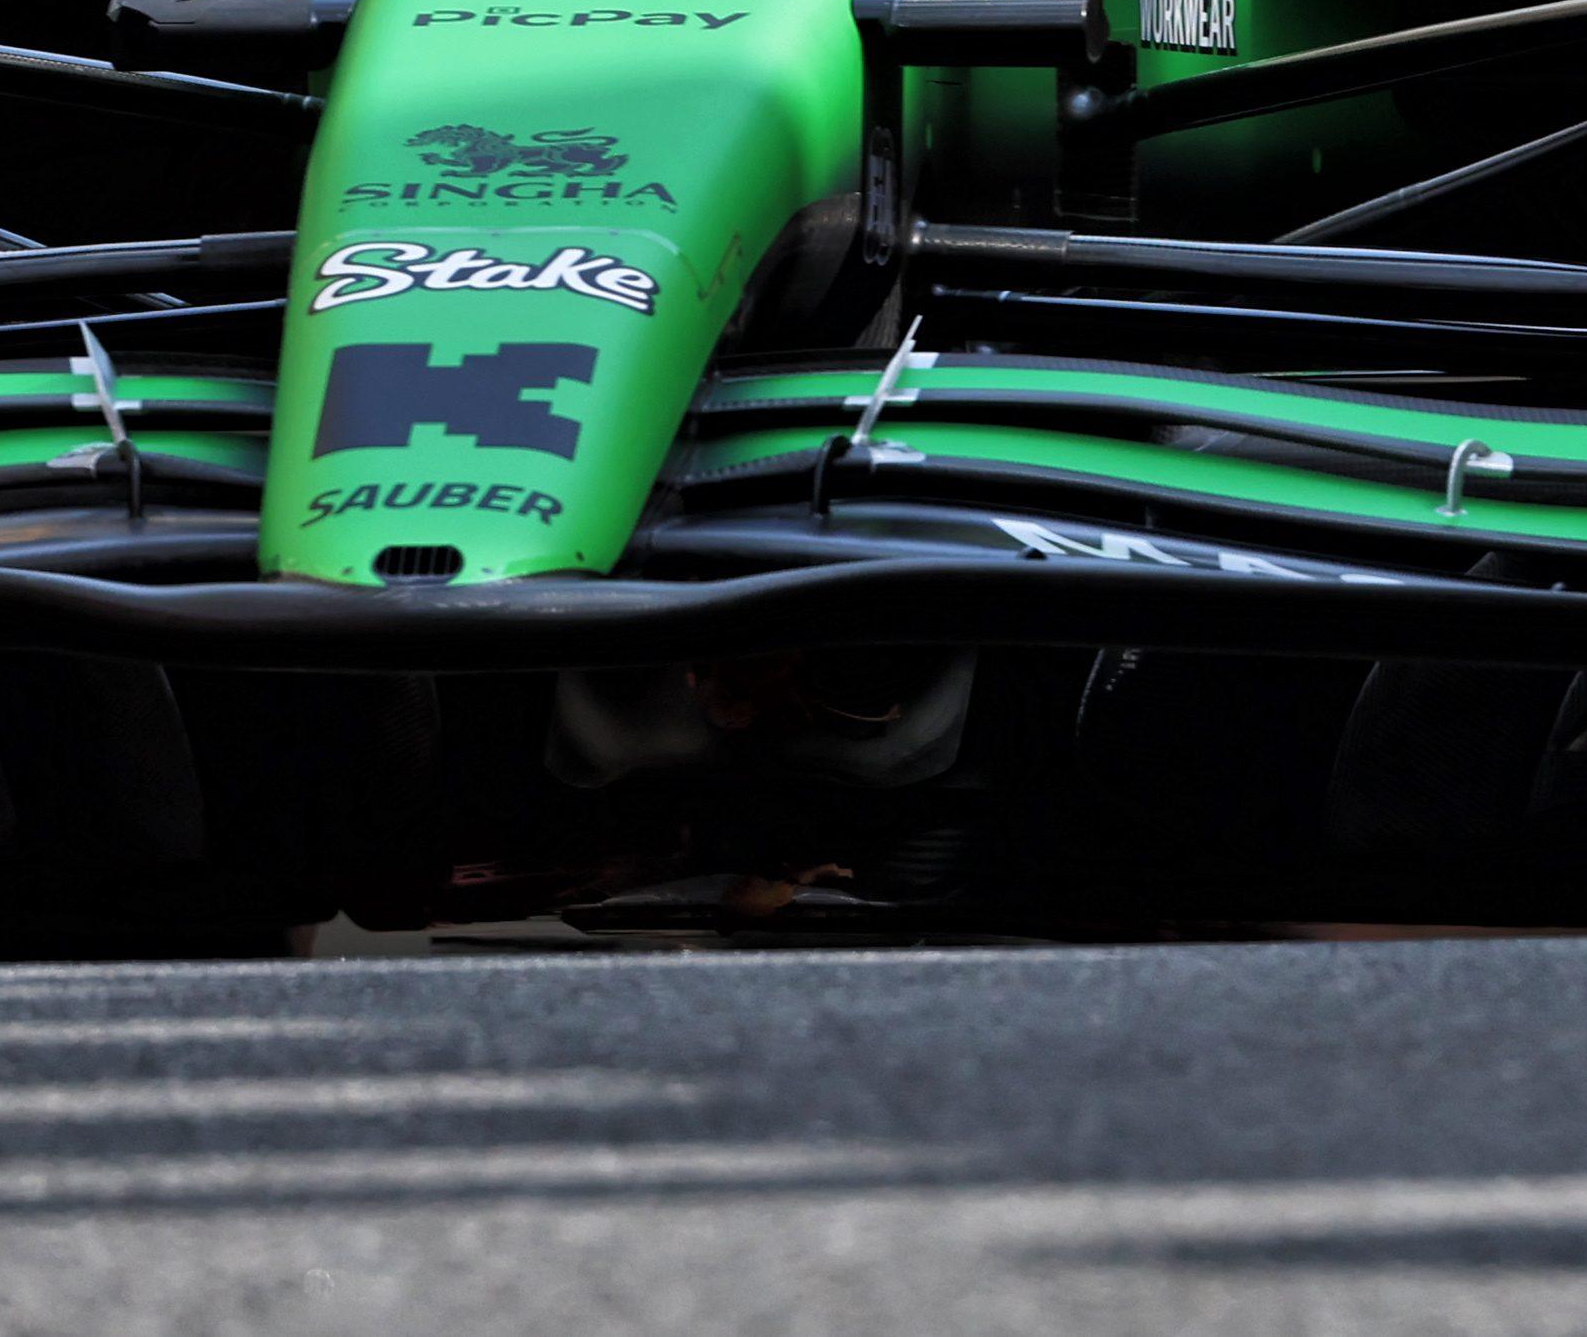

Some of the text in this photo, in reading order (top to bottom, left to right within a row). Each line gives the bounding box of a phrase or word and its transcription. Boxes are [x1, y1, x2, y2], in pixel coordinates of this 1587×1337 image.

[412, 7, 751, 30] PicPay
[342, 181, 681, 206] SINGHA
[308, 241, 661, 315] Stake
[300, 482, 564, 529] SAUBER
